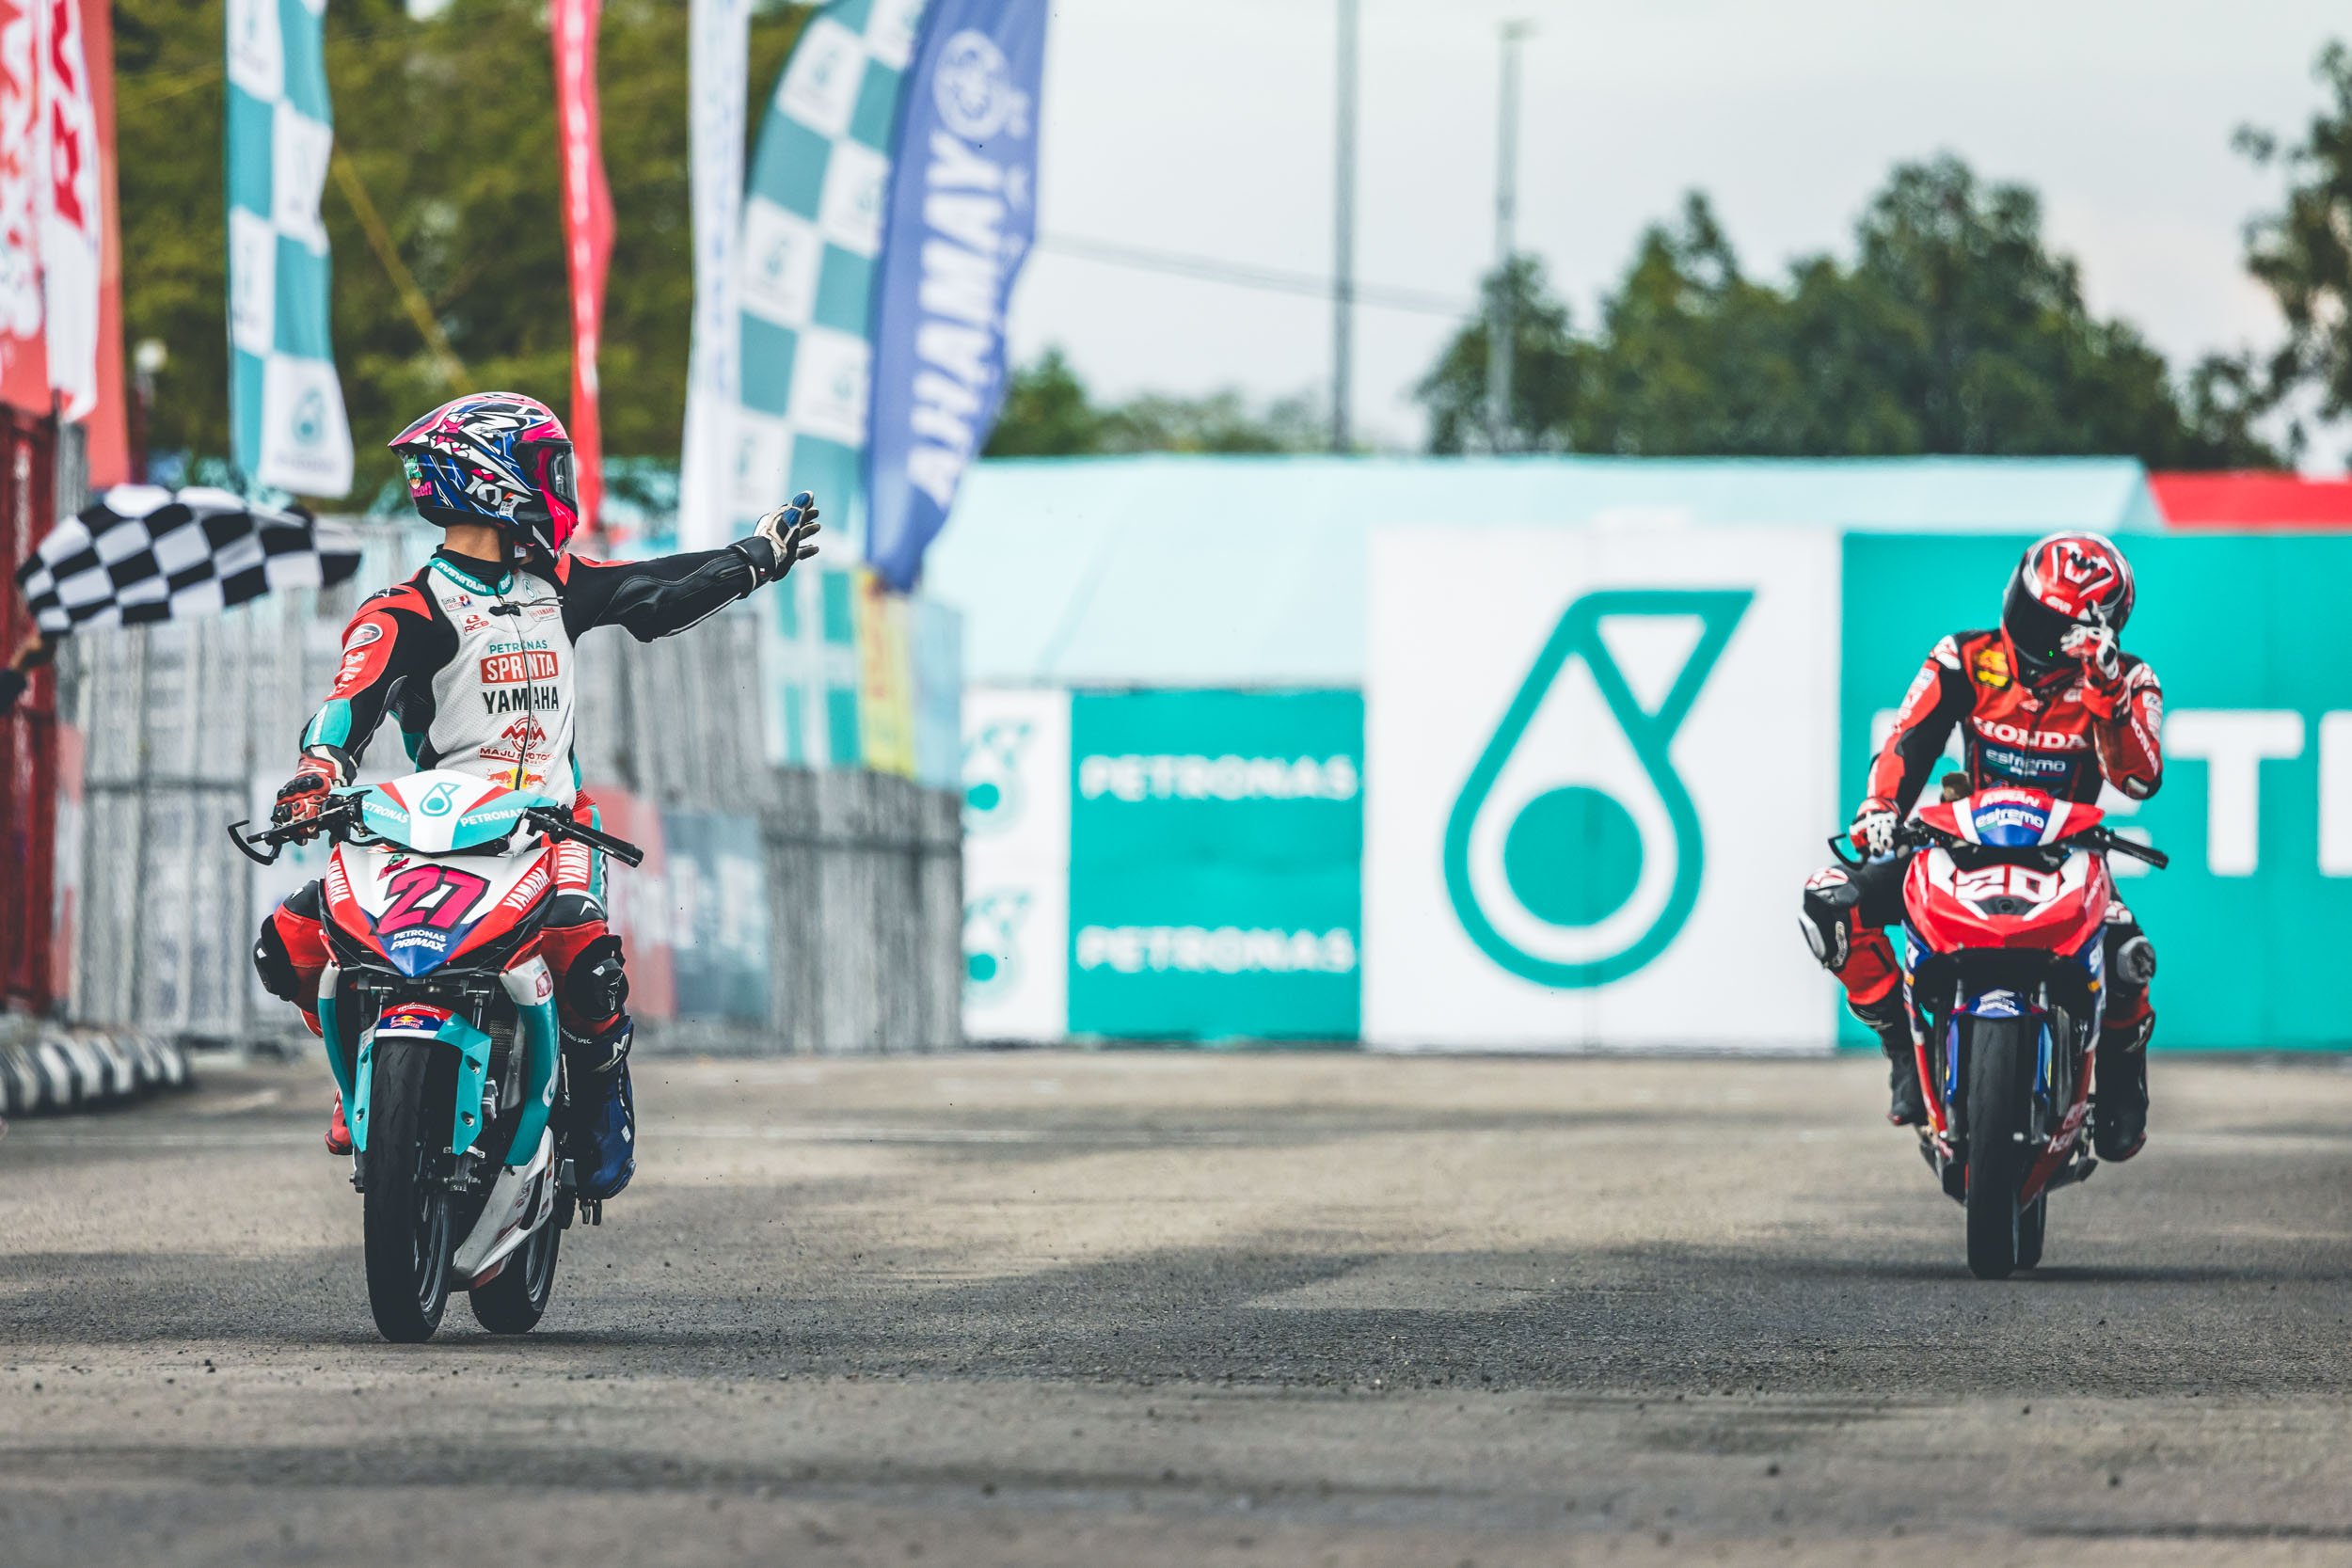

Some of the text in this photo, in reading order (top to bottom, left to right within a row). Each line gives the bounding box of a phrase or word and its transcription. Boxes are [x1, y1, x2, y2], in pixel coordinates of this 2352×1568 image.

[489, 640, 548, 654] PETRNAS
[482, 686, 559, 714] YAMAHA
[1972, 716, 2088, 749] HONDA
[480, 748, 515, 758] MAJU
[1079, 754, 1359, 801] PETRONAS
[326, 860, 351, 907] YAMAHA
[372, 863, 490, 937] 27
[502, 866, 550, 911] YAMAHA
[1956, 865, 2059, 902] 20
[390, 937, 448, 952] PRIMAX
[393, 929, 446, 942] PETRONAS
[1076, 925, 1356, 973] PETRONAS
